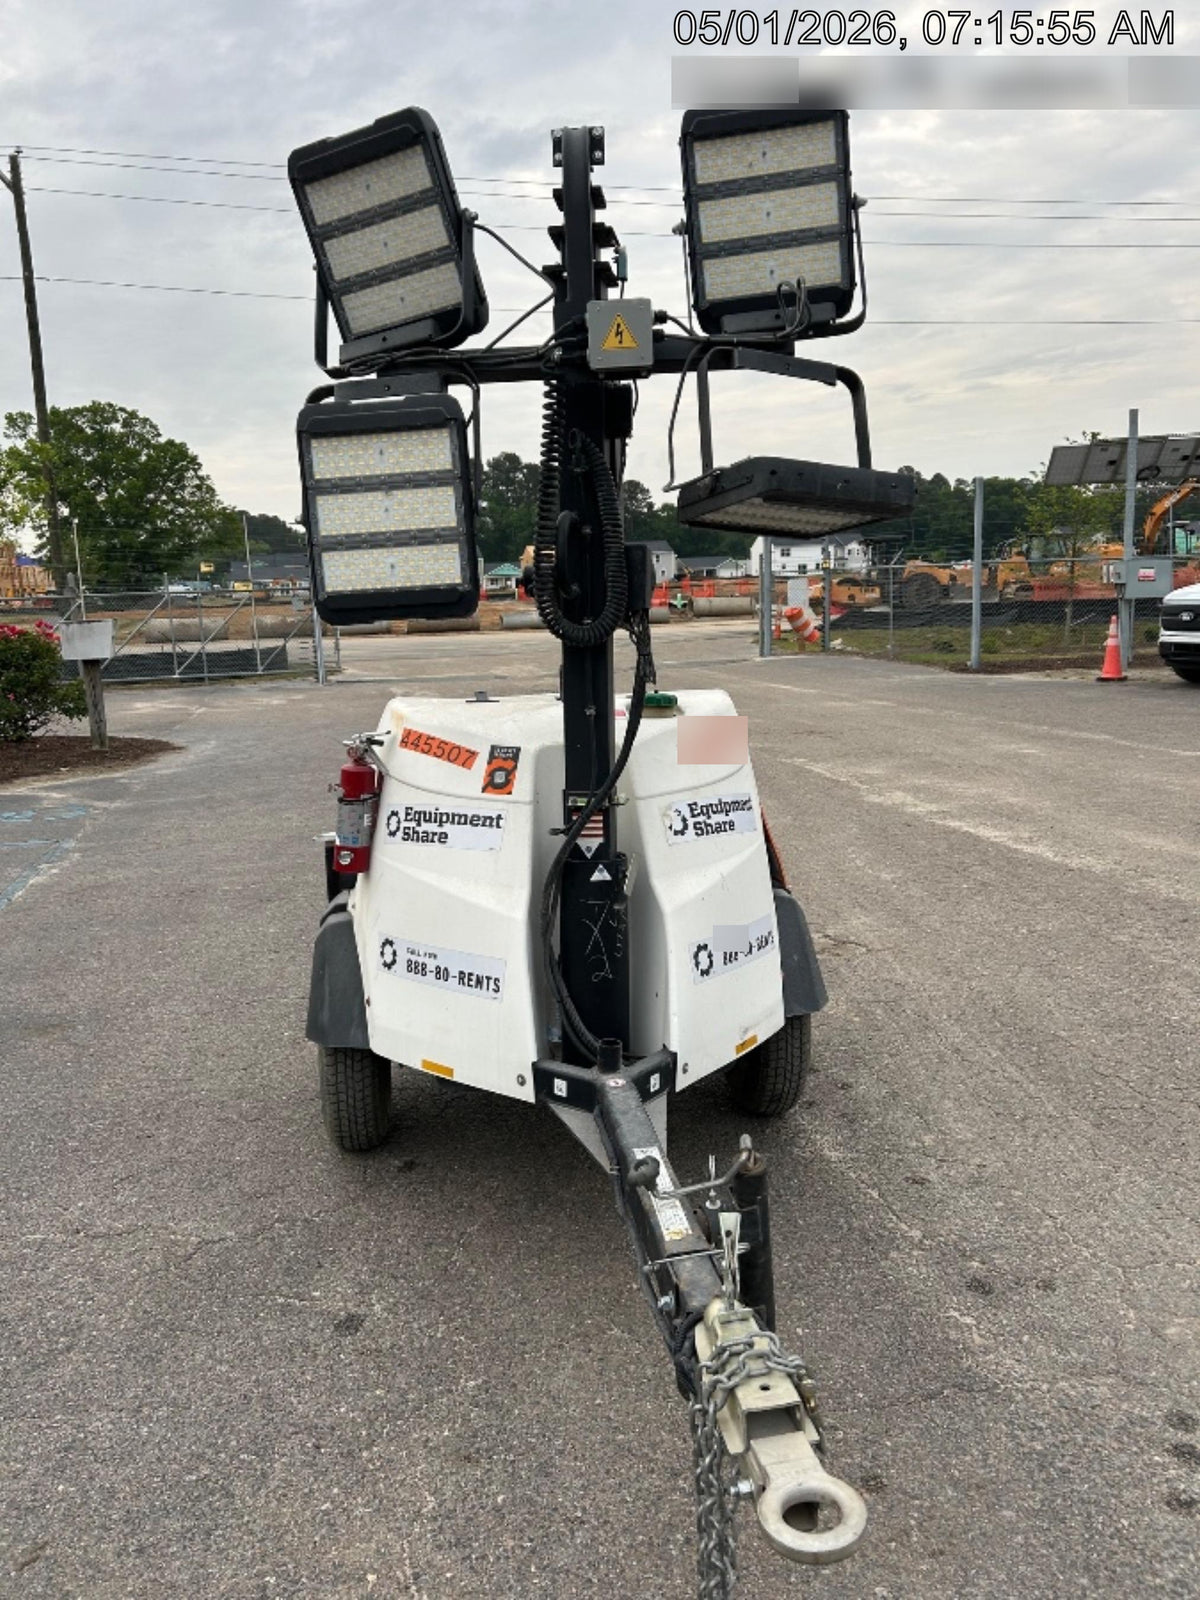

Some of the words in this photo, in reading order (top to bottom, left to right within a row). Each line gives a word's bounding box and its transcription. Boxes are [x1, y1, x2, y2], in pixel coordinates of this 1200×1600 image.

[400, 728, 476, 767] 445507
[403, 806, 504, 829] Equipment
[693, 819, 735, 837] Share
[401, 826, 449, 844] Share
[406, 958, 501, 993] 888-80-RENTS
